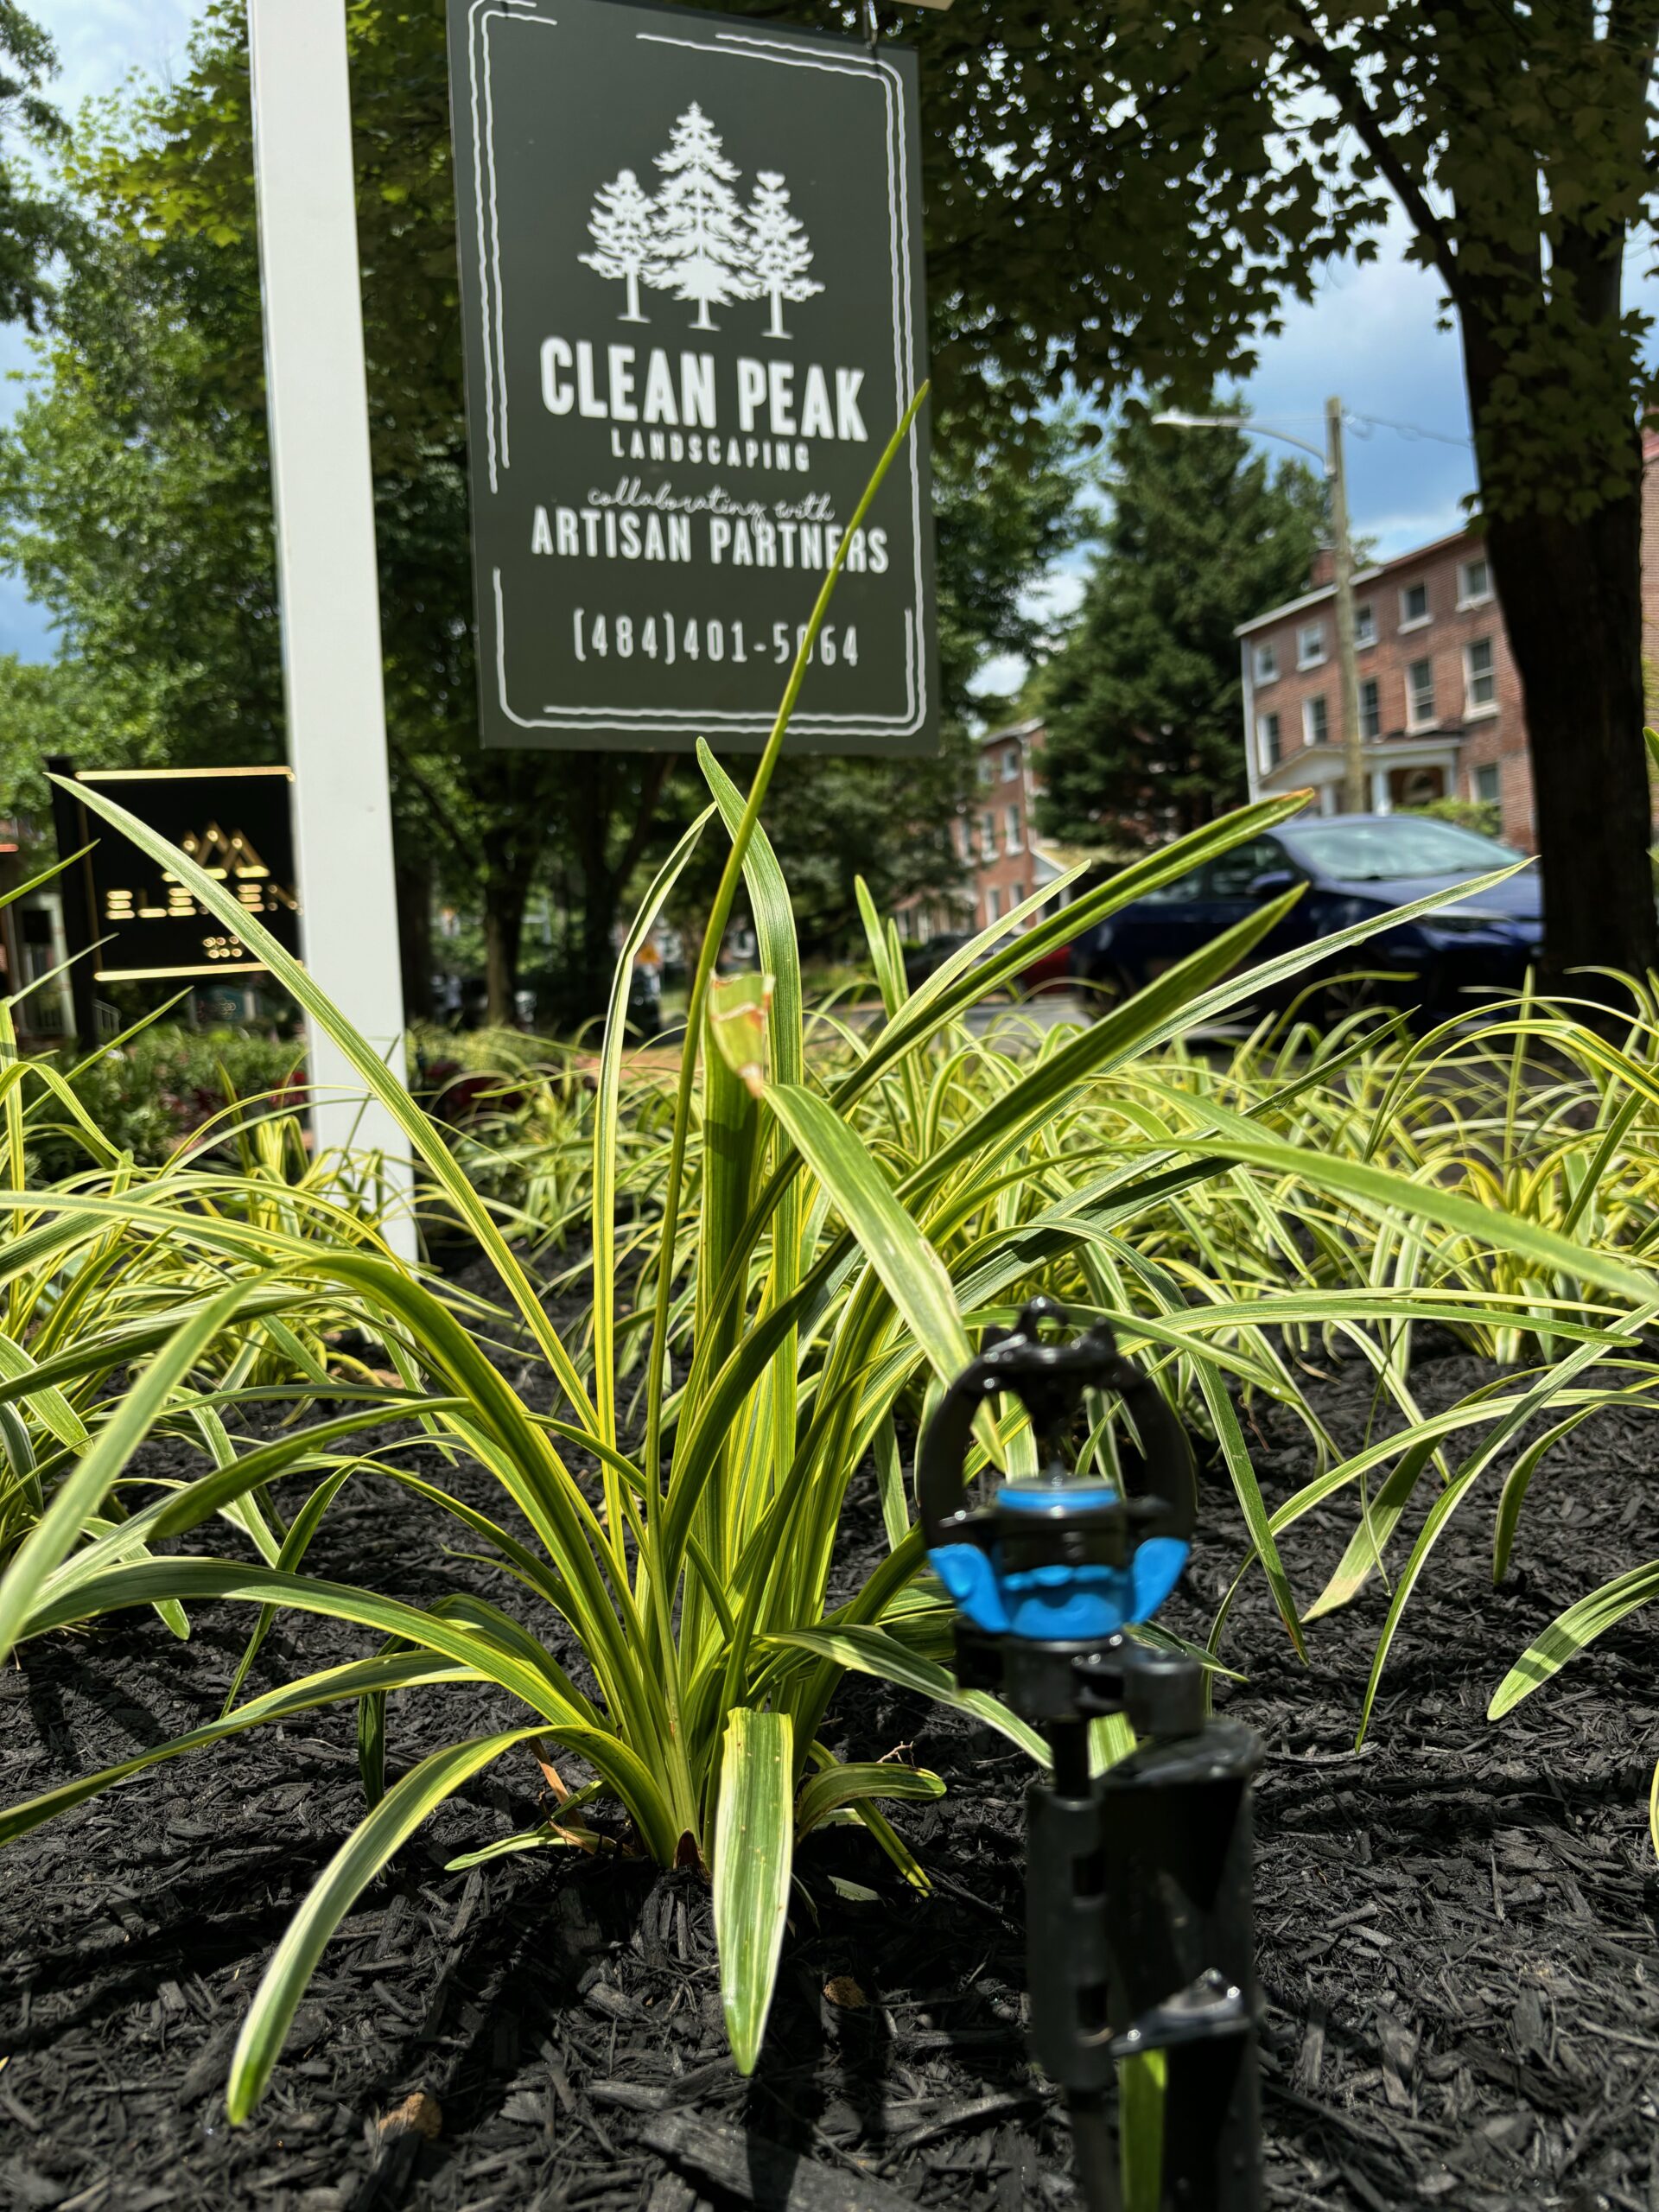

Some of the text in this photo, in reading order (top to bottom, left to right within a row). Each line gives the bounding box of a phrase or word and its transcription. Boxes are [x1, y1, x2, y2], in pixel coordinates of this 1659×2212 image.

[541, 336, 868, 442] CLEAN PEAK
[611, 427, 810, 472] LANDSCAPING
[531, 505, 889, 574] ARTISAN PARTNERS
[588, 476, 836, 540] collaborating with
